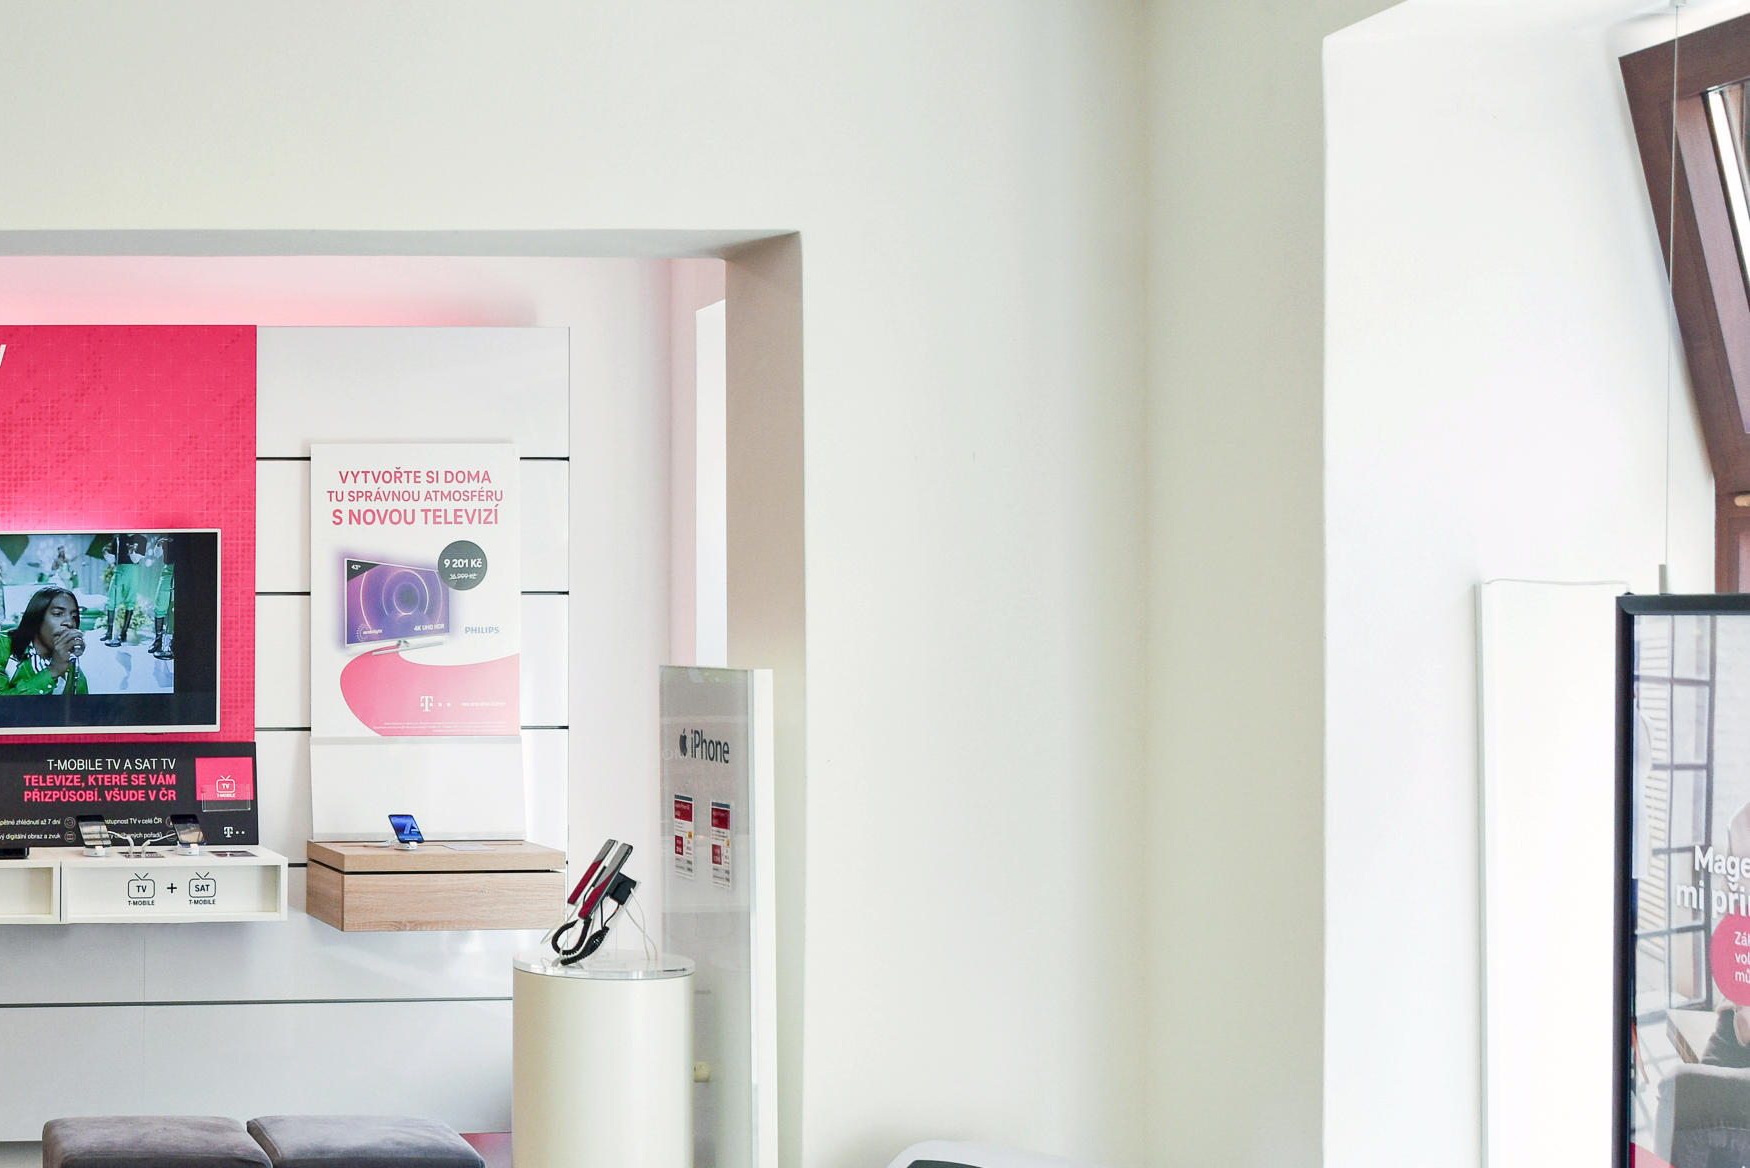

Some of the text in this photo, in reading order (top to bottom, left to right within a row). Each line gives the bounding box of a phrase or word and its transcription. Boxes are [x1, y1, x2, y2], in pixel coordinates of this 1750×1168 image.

[339, 467, 492, 484] VYTVOŘTE SI DOMA
[327, 487, 504, 502] TU SPRÁVNOU ATMOSFÉRU
[332, 504, 500, 526] S NOVOU TELEVIZÍ
[470, 558, 483, 568] Kč
[464, 626, 500, 634] PHILIPS
[690, 728, 730, 764] iPhone
[46, 758, 176, 771] T-MOBILE TV A SAT TV
[23, 772, 176, 787] TELEVIZE, KTERÉ SE VÁM
[24, 787, 177, 802] PŘIZPŮSOBÍ. VŠUDE V ČR
[153, 816, 163, 824] ČR
[136, 885, 147, 893] TV
[194, 884, 210, 893] SAT
[1676, 880, 1750, 918] mi při
